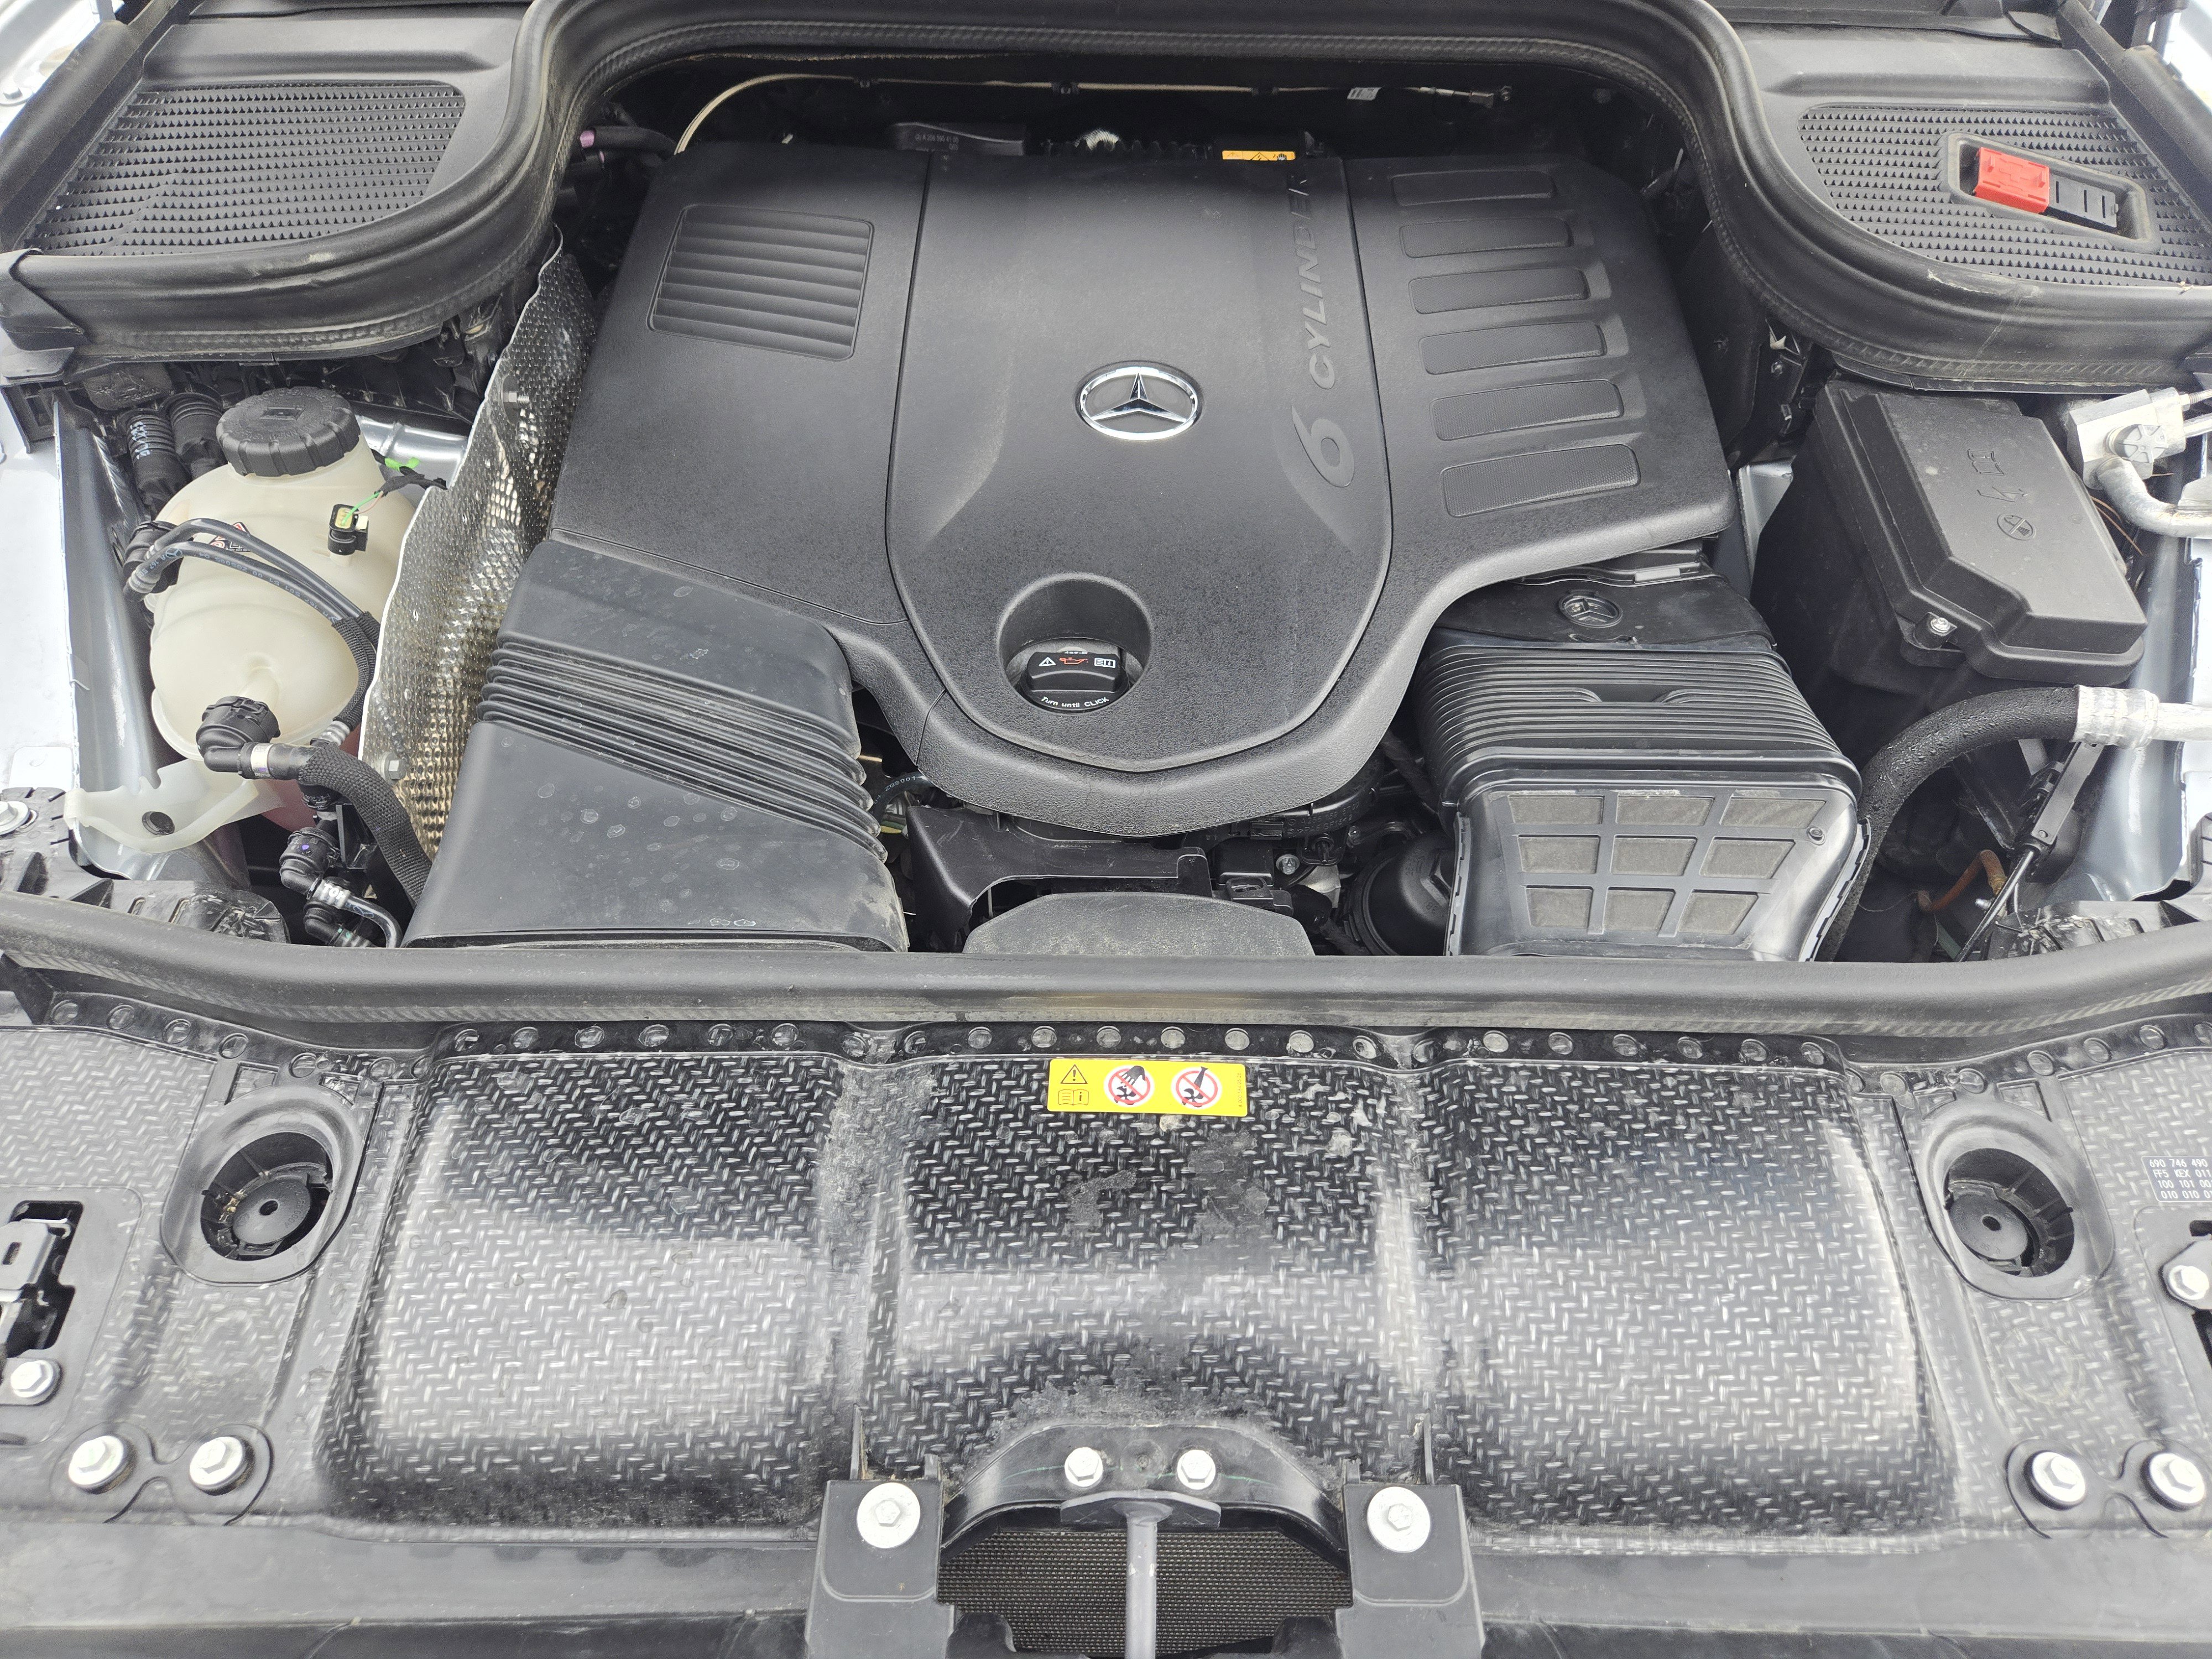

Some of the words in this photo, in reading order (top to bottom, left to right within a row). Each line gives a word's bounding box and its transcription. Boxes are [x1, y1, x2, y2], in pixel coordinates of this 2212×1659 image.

[1291, 405, 1355, 488] 6
[1041, 696, 1058, 706] Turn
[1084, 697, 1109, 707] CLICK
[2149, 1159, 2166, 1167] 690
[2169, 1159, 2187, 1167] 746
[2191, 1159, 2208, 1167] 490
[2152, 1169, 2169, 1178] FF5
[2157, 1180, 2174, 1188] 100
[2179, 1180, 2195, 1188] 101
[2199, 1180, 2212, 1188] 00
[2161, 1190, 2178, 1199] 010
[2182, 1190, 2200, 1199] 010
